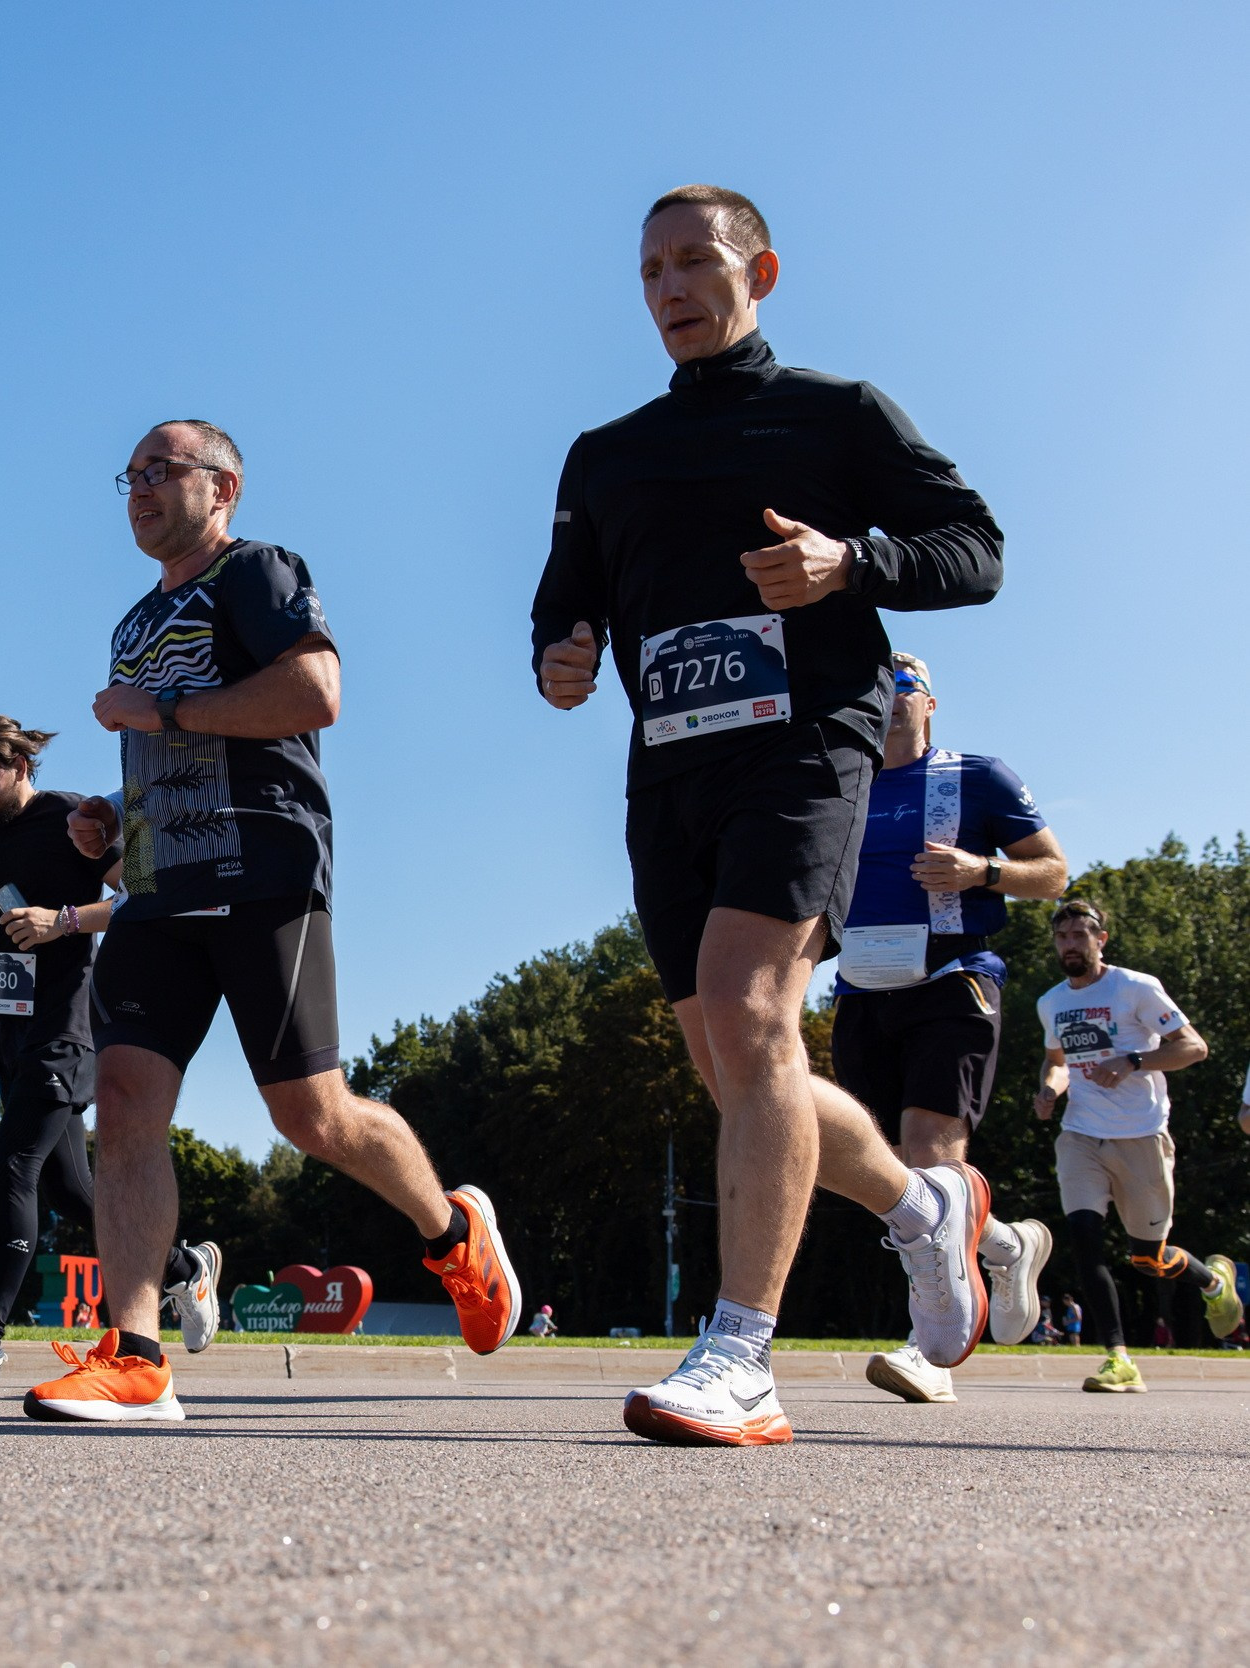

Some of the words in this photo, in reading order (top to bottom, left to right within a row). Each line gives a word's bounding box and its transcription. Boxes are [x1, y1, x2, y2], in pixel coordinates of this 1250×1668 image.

[743, 428, 781, 436] CRAFT
[668, 651, 746, 694] 7276
[701, 709, 740, 723] ЭВОКОМ
[1067, 1032, 1098, 1047] 7080
[325, 1282, 344, 1302] Я
[242, 1293, 301, 1314] люблю
[303, 1302, 344, 1313] наш
[247, 1313, 294, 1331] парк!
